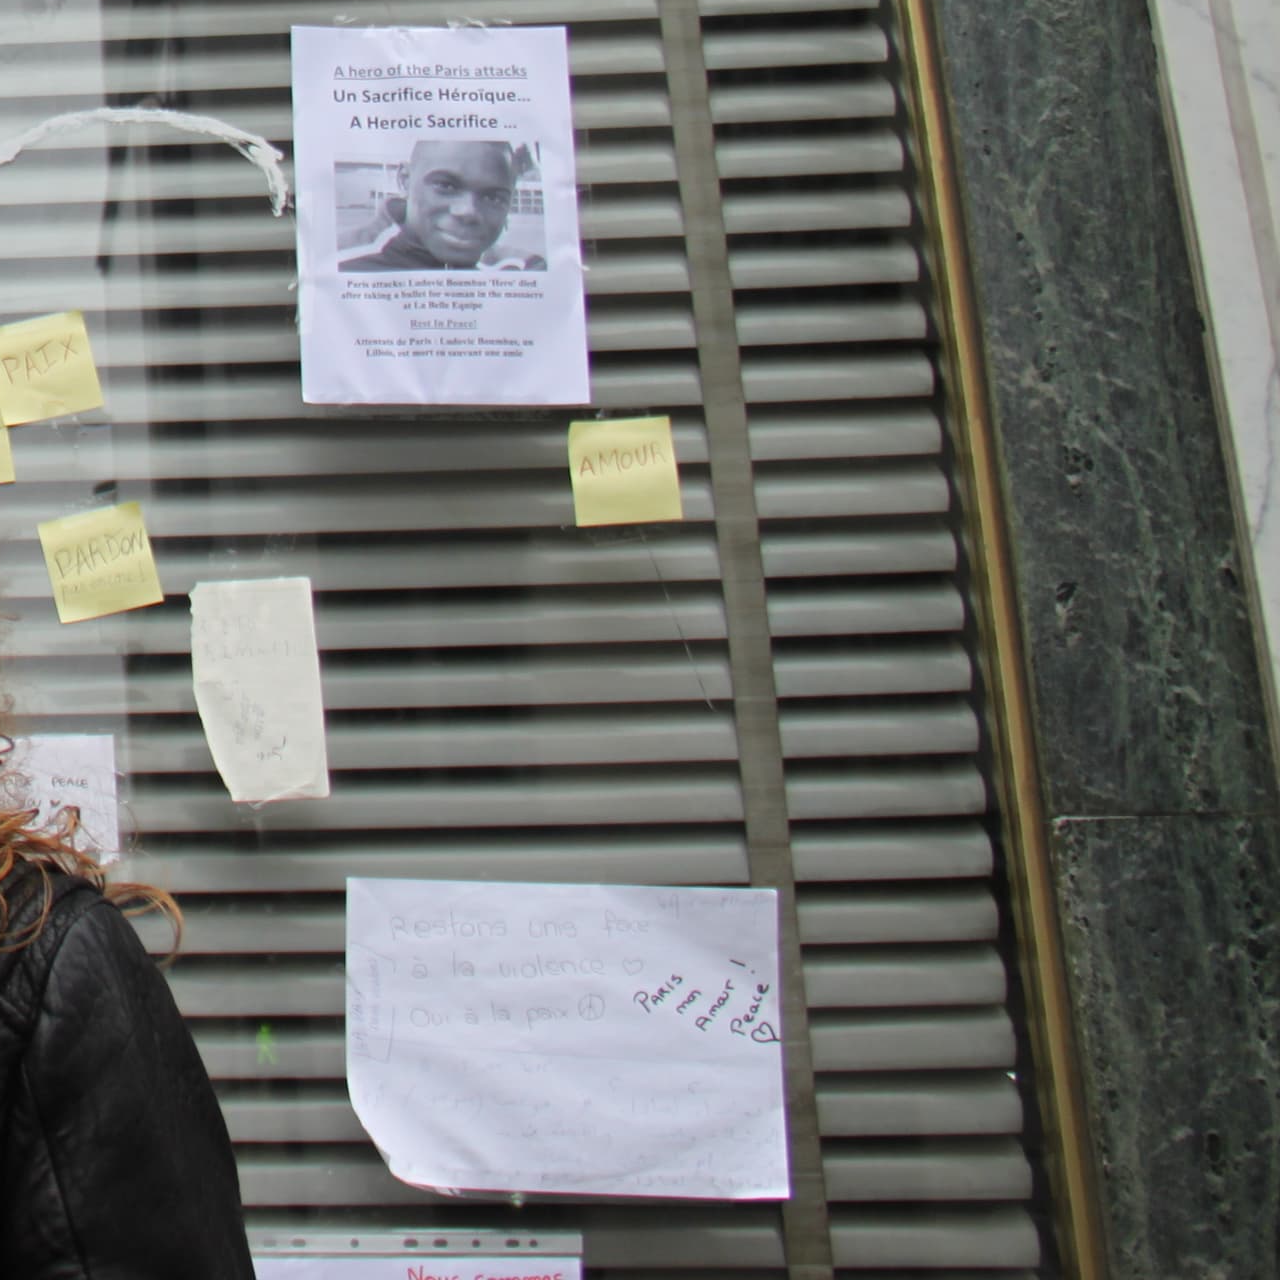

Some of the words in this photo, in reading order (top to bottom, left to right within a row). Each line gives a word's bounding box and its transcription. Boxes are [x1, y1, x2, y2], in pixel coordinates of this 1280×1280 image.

[334, 66, 344, 78] A
[349, 65, 382, 78] hero
[387, 64, 403, 77] of
[407, 64, 430, 77] the
[435, 65, 470, 78] Paris
[475, 65, 528, 78] attacks
[333, 90, 357, 104] Un
[362, 88, 433, 104] Sacrifice
[350, 116, 362, 129] A
[367, 115, 423, 130] Heroic
[427, 114, 498, 130] Sacrifice
[347, 279, 369, 288] Paris
[408, 279, 443, 288] Ludovic
[519, 278, 537, 288] died
[341, 291, 362, 300] after
[364, 291, 392, 301] taking
[401, 290, 426, 299] bullet
[429, 290, 441, 299] for
[444, 291, 476, 299] woman
[488, 290, 501, 298] the
[410, 319, 431, 329] Rest
[0, 337, 79, 386] PAIX
[578, 439, 668, 478] AMOUR
[53, 527, 146, 580] PARDON
[631, 972, 685, 1016] PARIS
[675, 987, 703, 1016] mon
[729, 980, 771, 1038] Peace
